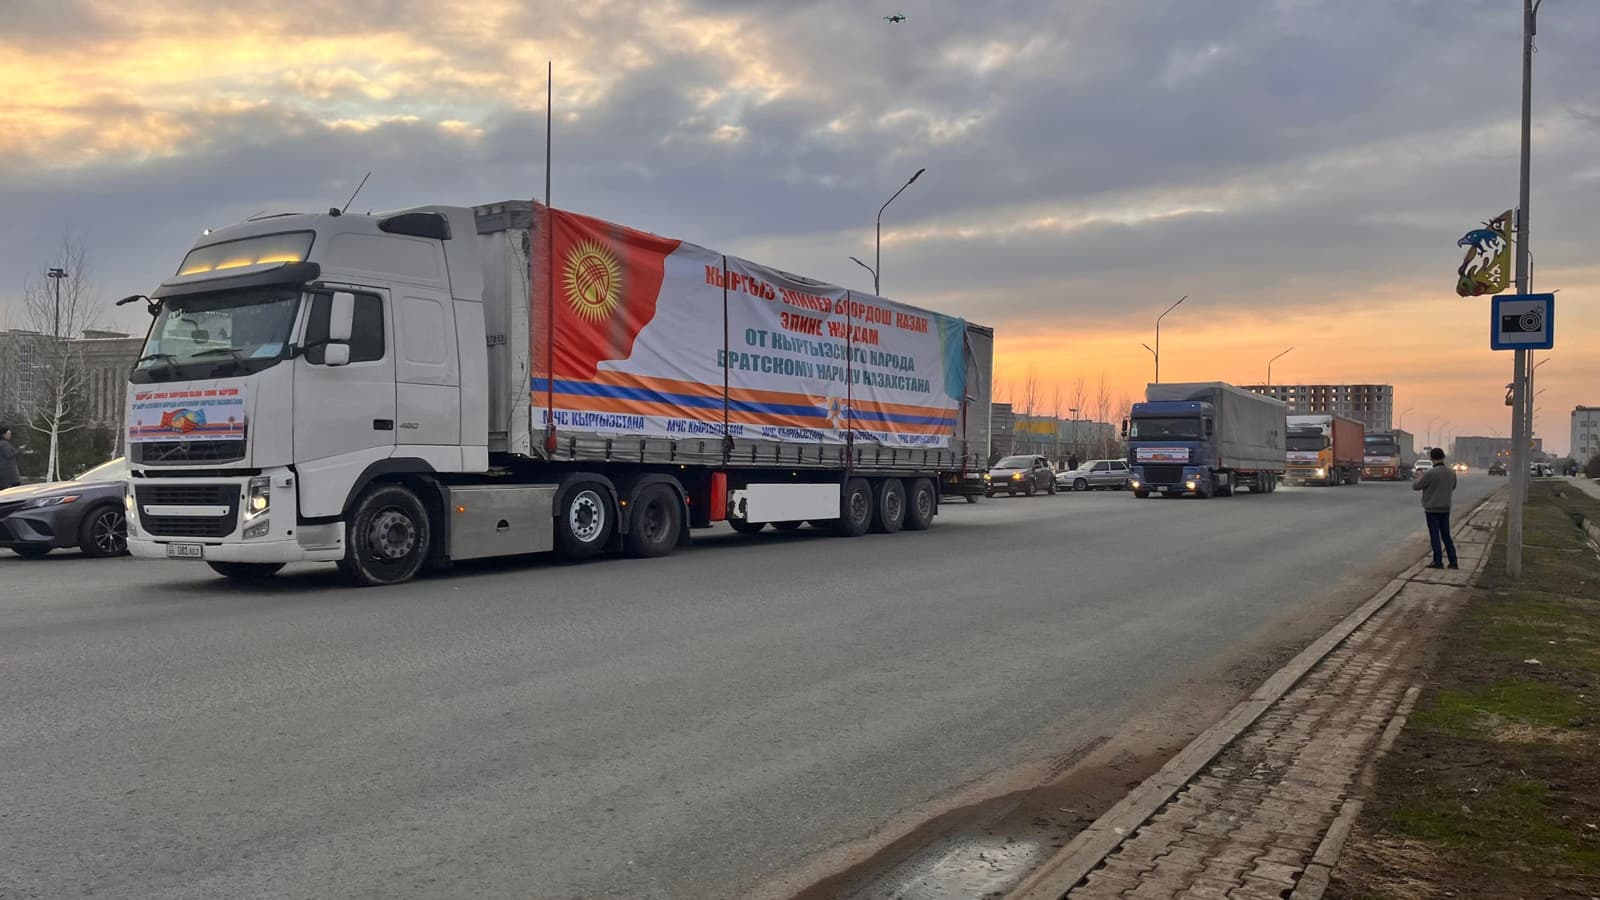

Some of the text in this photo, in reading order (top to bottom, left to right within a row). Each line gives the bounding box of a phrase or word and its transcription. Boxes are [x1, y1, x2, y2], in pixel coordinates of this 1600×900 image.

[704, 265, 776, 300] КЫРГЫЗ
[779, 288, 832, 313] ЭЛИНЕН
[896, 311, 928, 334] КАЗАК
[780, 312, 823, 336] ЭЛИНЕ
[745, 328, 767, 347] ОТ
[869, 350, 915, 373] НАРОДА
[717, 349, 813, 378] БРАТСКОМУ
[863, 370, 930, 393] КАЗАХСТАНА
[571, 411, 644, 430] КЫРГЫЗСТАНА
[667, 420, 686, 433] МЧС
